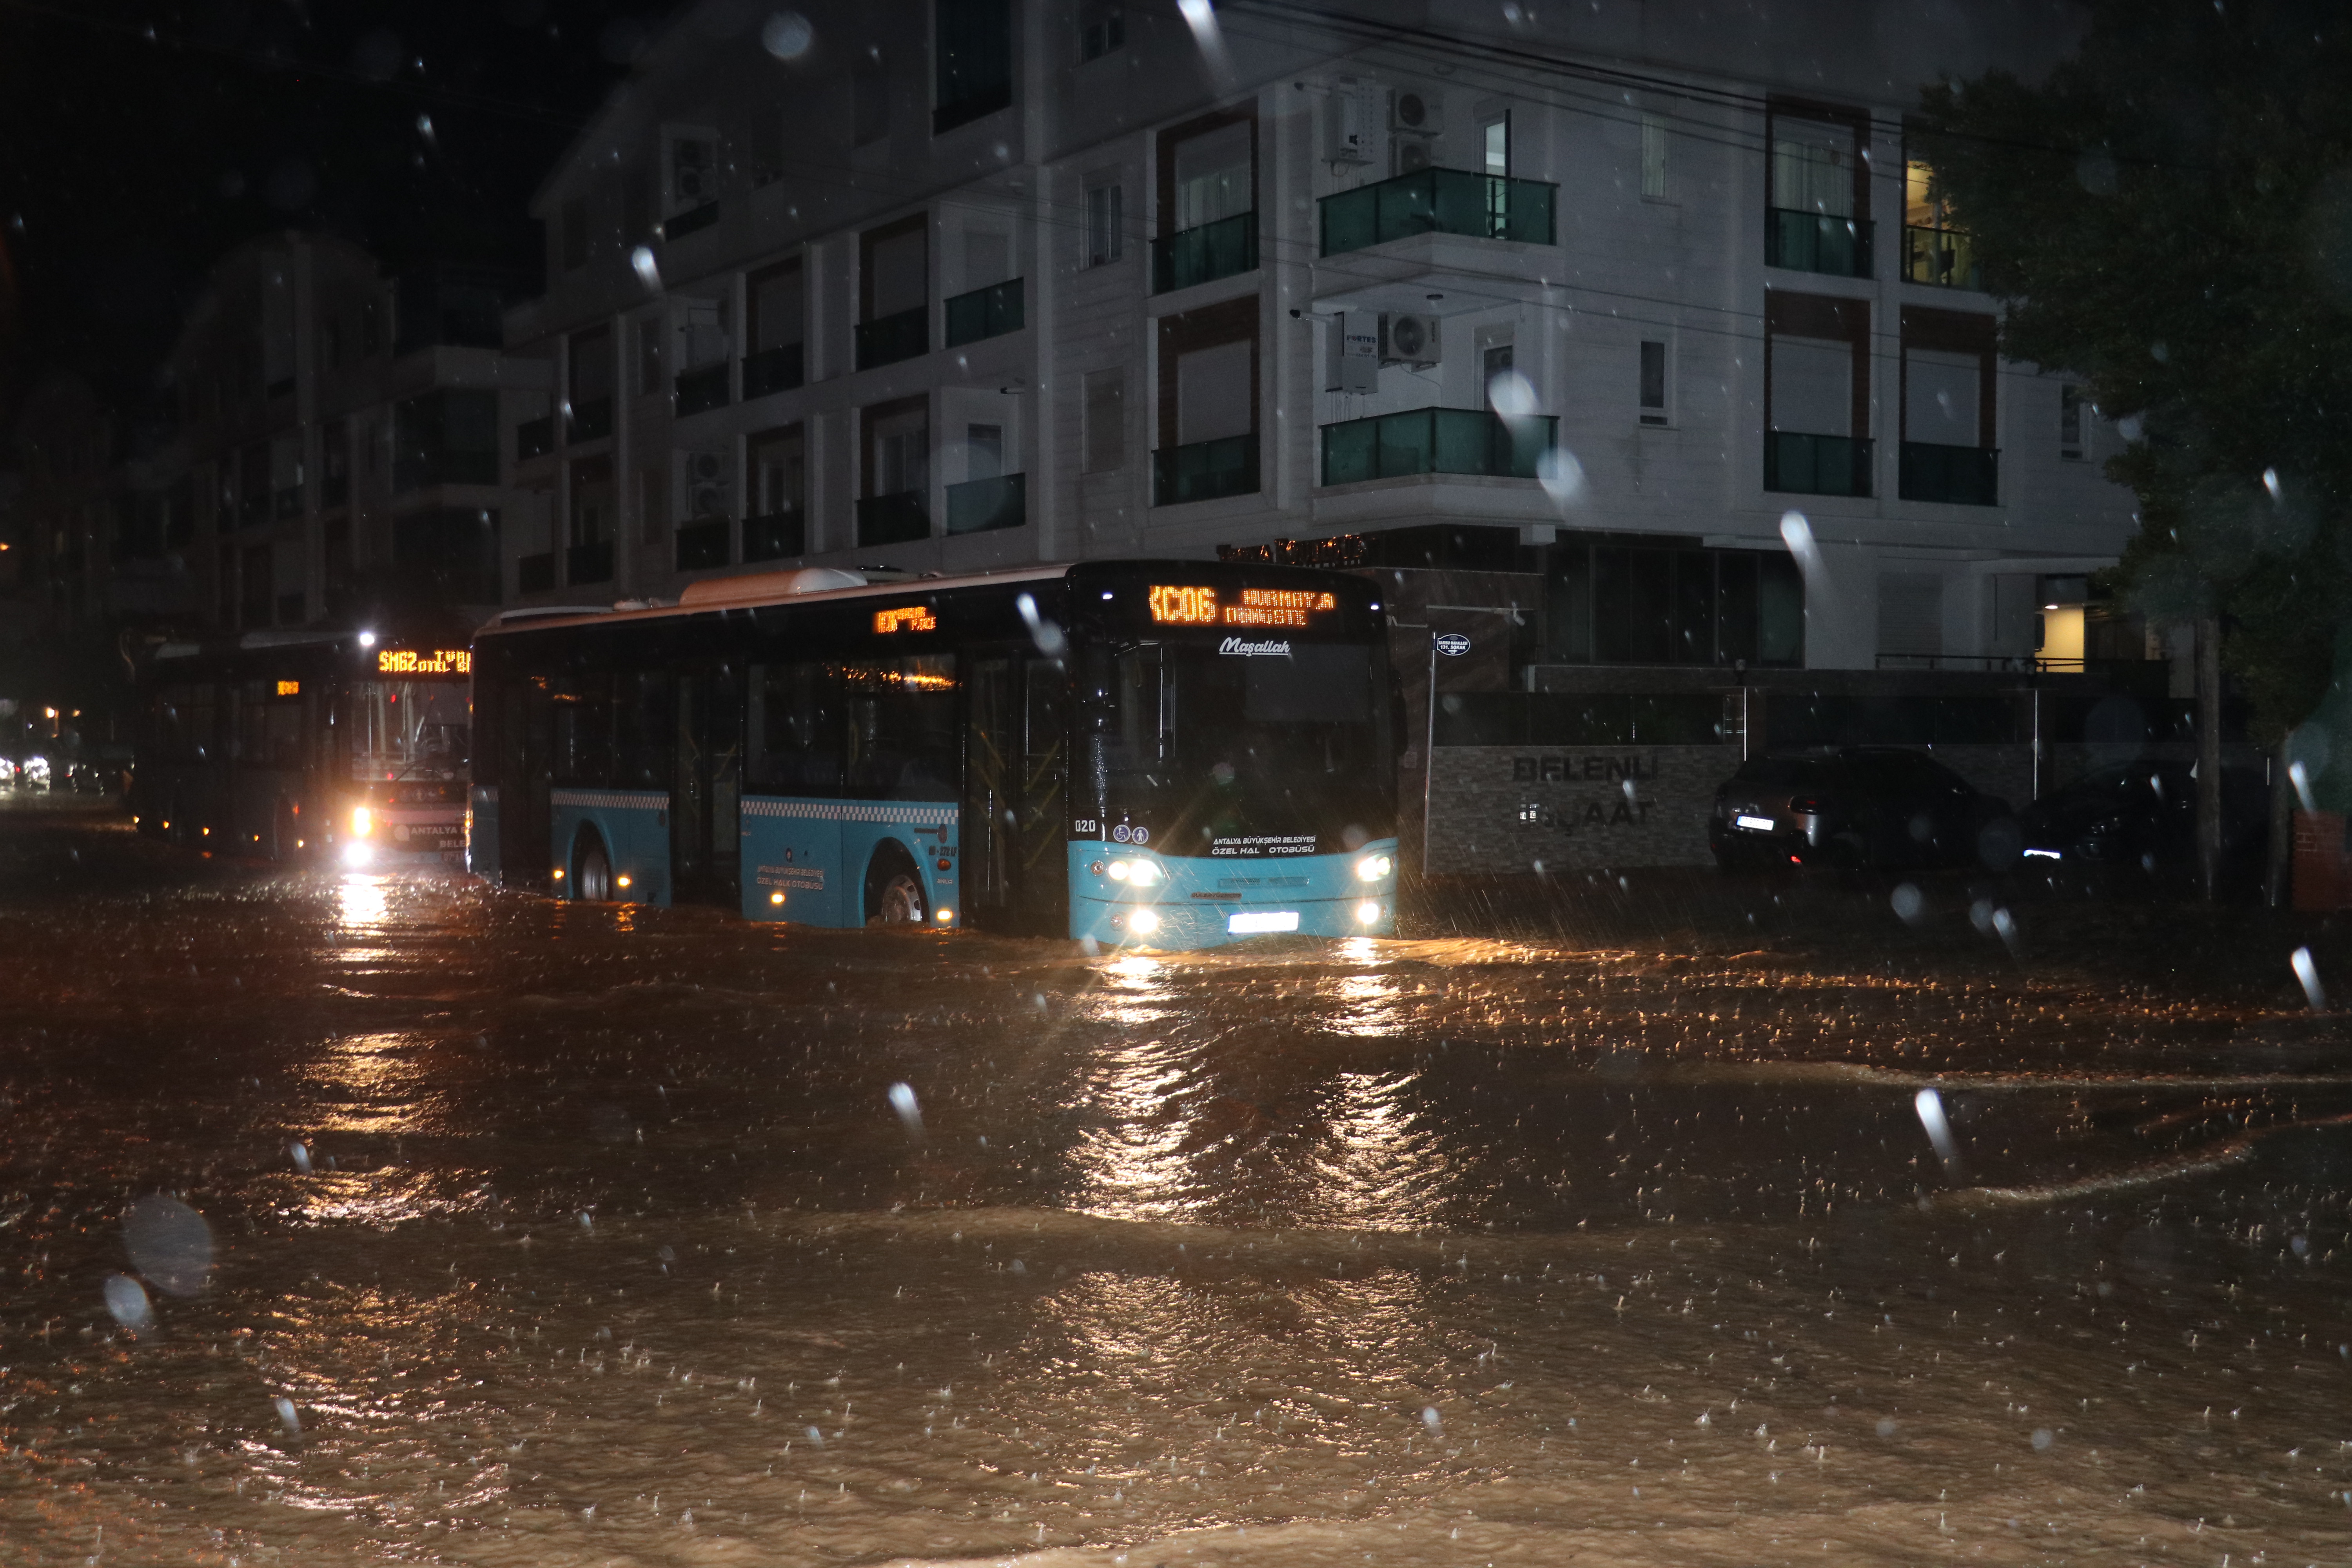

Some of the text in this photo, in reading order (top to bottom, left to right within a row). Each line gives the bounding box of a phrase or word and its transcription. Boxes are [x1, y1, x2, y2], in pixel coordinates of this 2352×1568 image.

[1149, 586, 1216, 622] KC06
[1219, 637, 1290, 657] Maşallah
[379, 650, 417, 672] SM62
[1075, 820, 1096, 832] 020
[1243, 835, 1281, 846] BÜYÜKŞEHİR
[1283, 835, 1316, 843] BELEDİYESİ
[1269, 844, 1315, 853] OTOBÜSÜ
[774, 878, 790, 887] HALK
